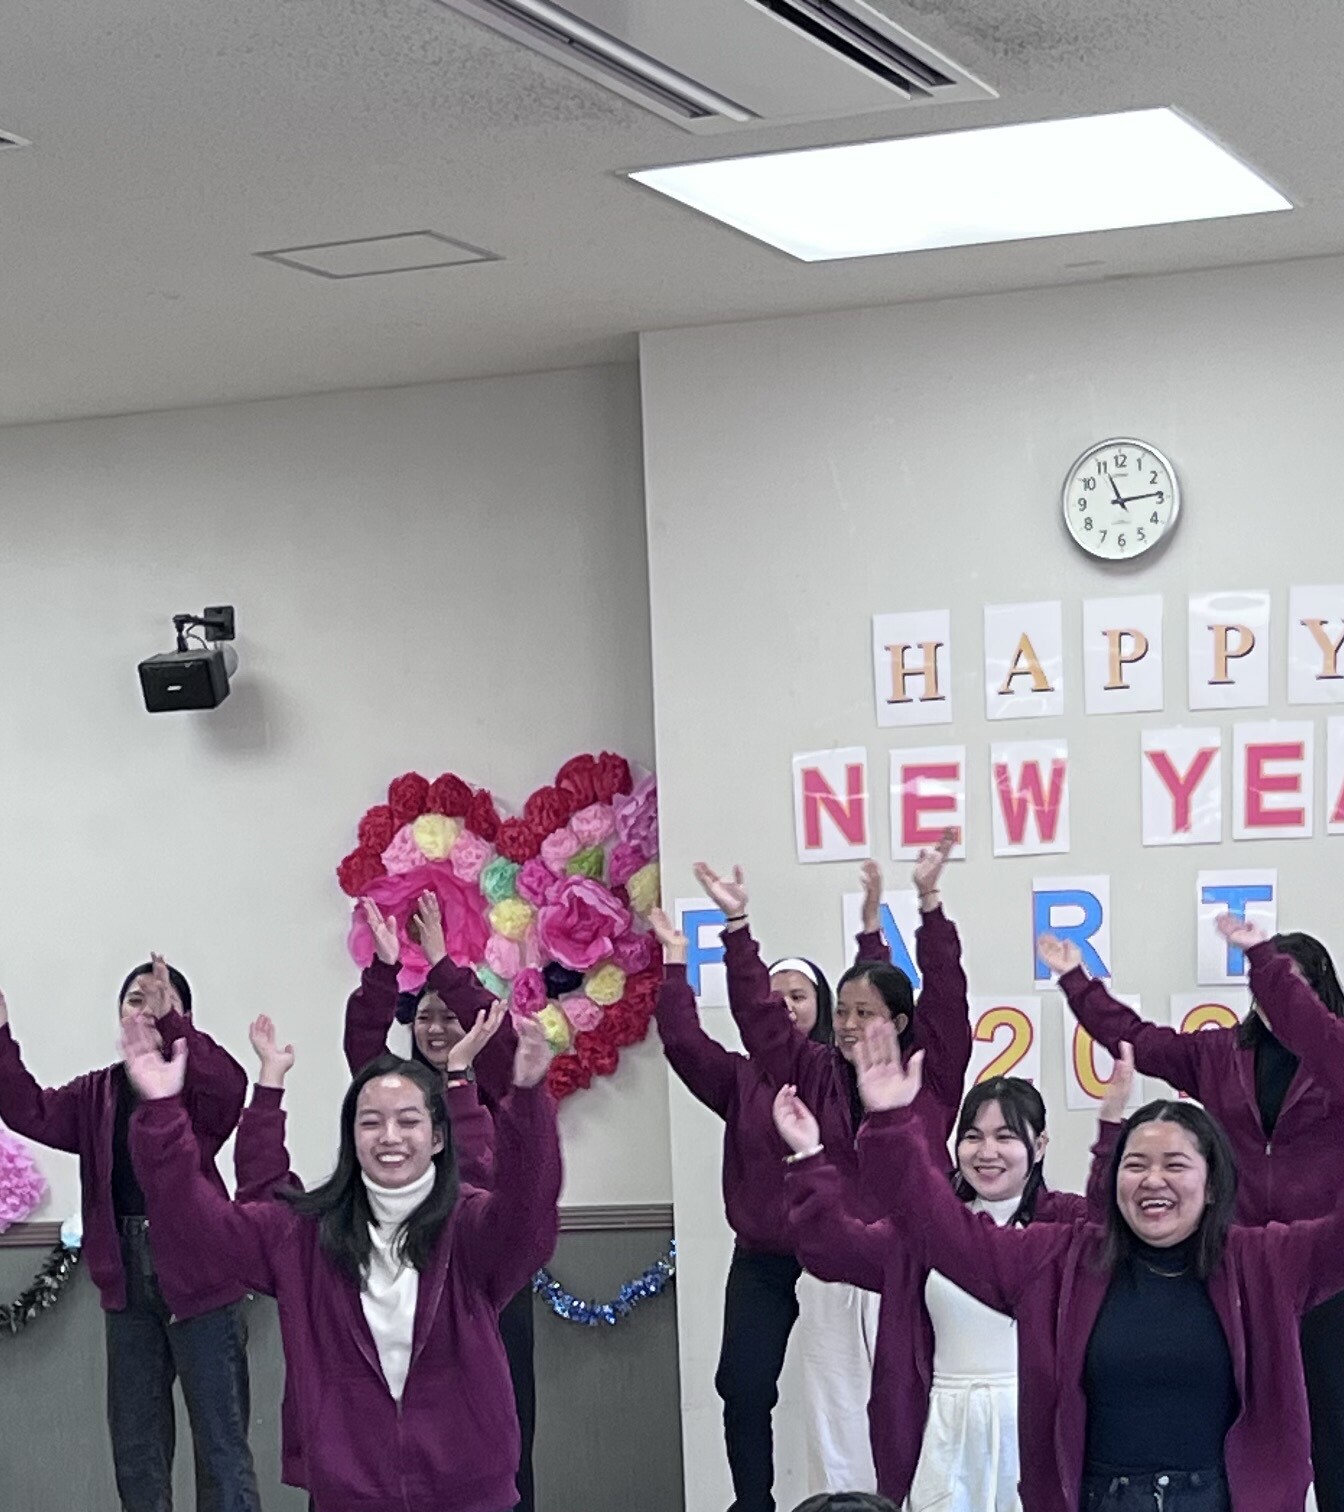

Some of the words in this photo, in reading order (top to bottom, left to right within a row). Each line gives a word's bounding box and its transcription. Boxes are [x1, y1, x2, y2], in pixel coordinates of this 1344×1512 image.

[1097, 460, 1108, 475] 11
[1113, 454, 1127, 468] 12
[1136, 457, 1142, 471] 1
[1082, 476, 1096, 491] 10
[1149, 471, 1158, 484] 2
[1156, 491, 1164, 504] 3
[1078, 498, 1087, 511] 9
[1084, 517, 1093, 530] 8
[1149, 511, 1159, 524] 4
[1099, 530, 1107, 543] 7
[1117, 533, 1126, 547] 6
[1137, 527, 1146, 540] 5
[801, 758, 1067, 850] NEW
